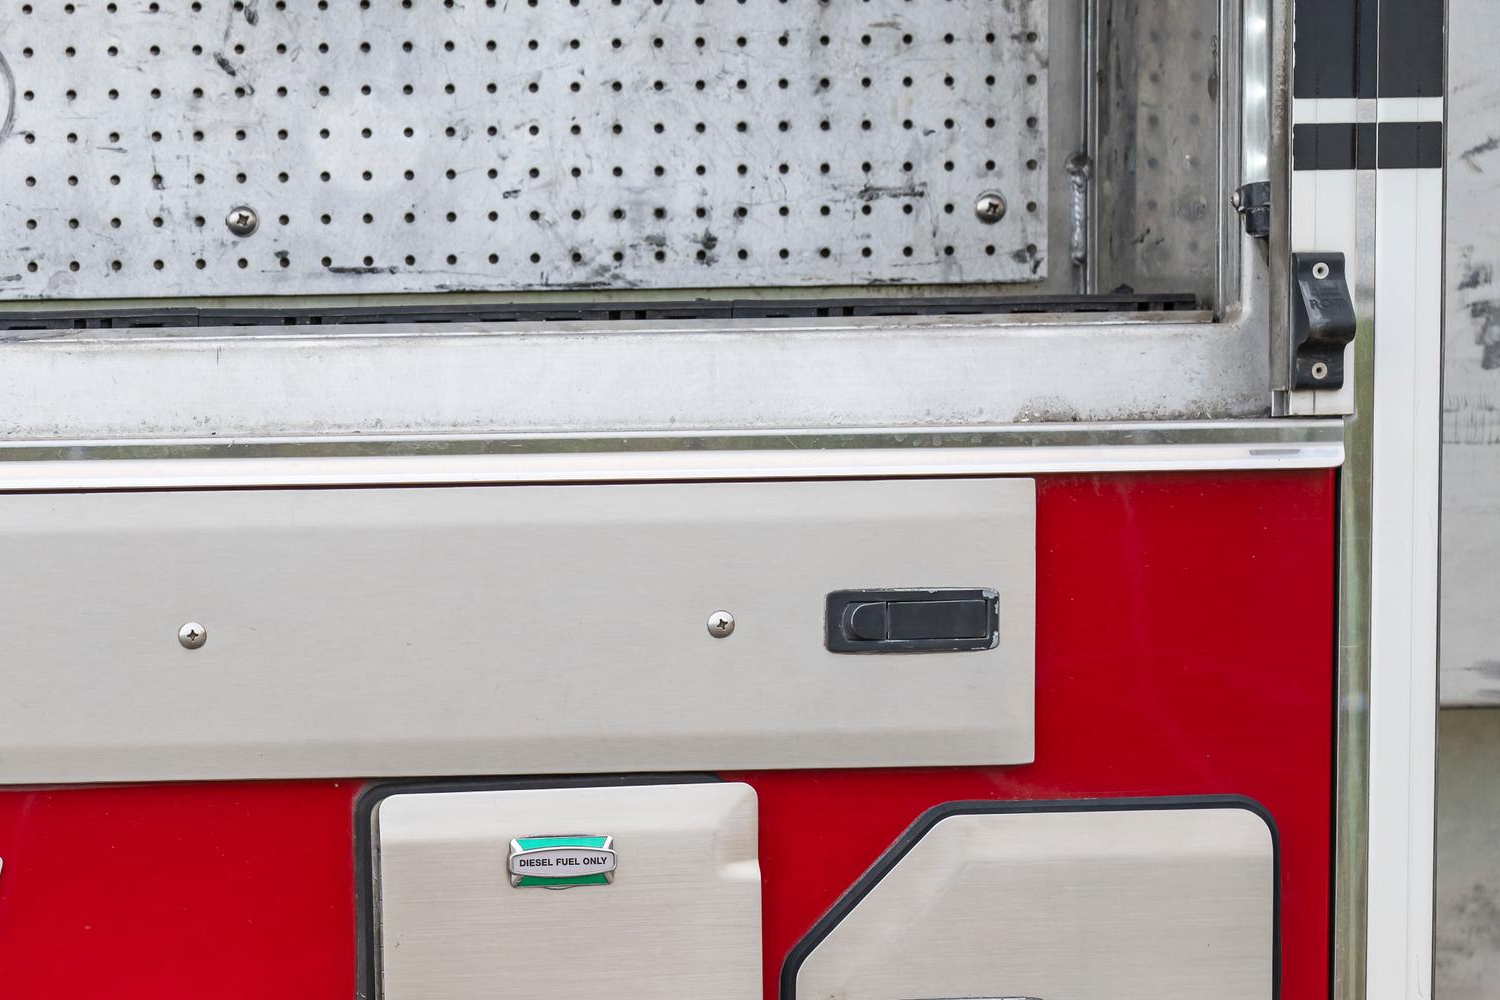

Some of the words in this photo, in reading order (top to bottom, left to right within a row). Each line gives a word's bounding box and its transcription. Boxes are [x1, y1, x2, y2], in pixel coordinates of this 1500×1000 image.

[519, 858, 553, 867] DIESEL
[556, 857, 580, 866] FUEL
[583, 856, 608, 865] ONLY
